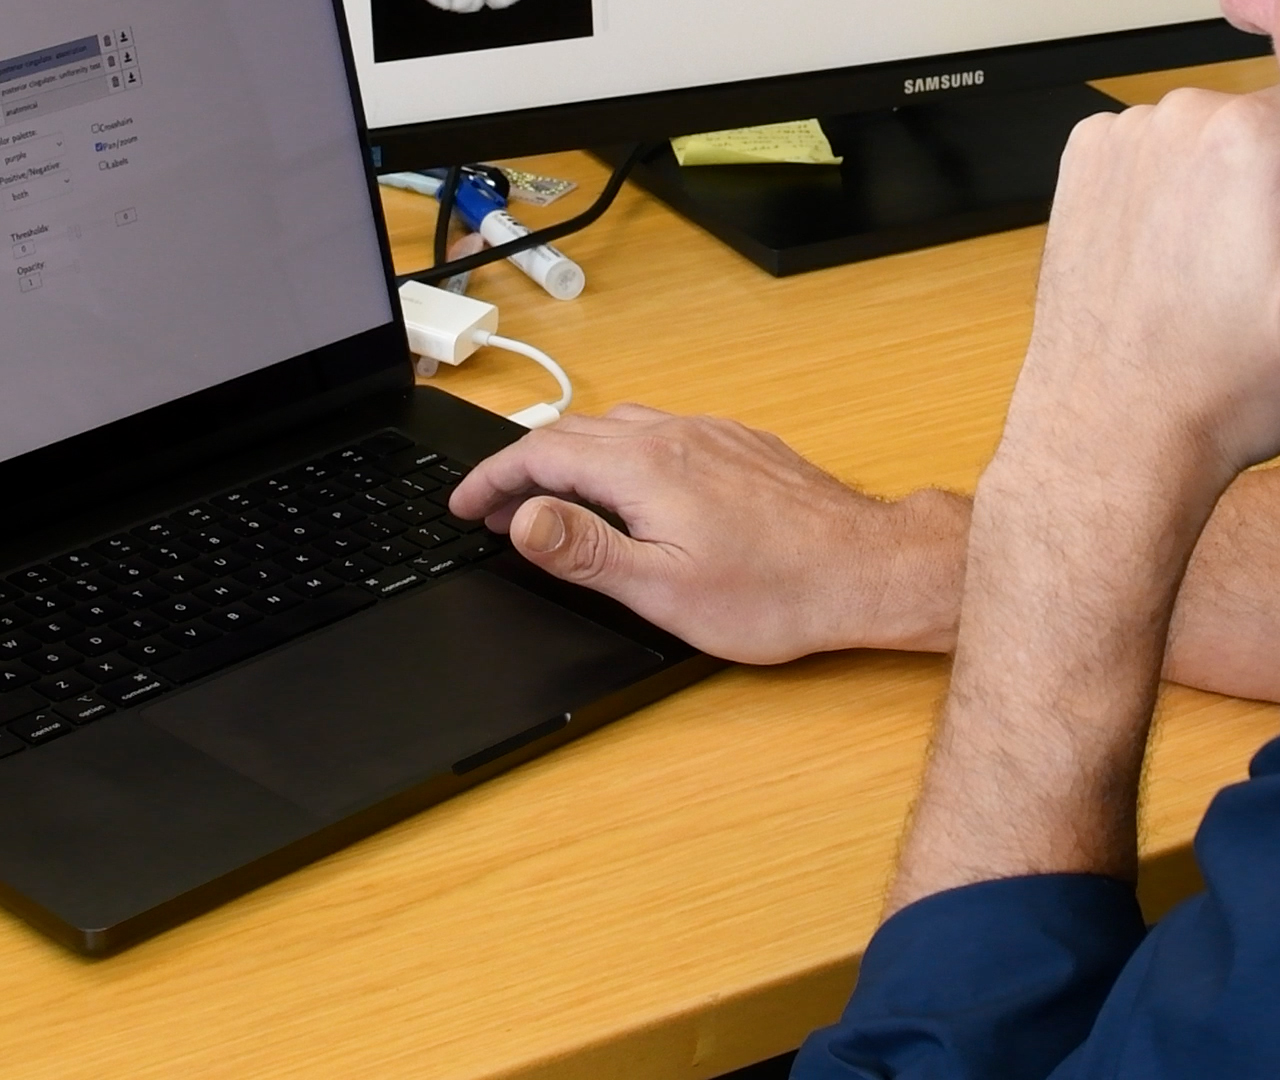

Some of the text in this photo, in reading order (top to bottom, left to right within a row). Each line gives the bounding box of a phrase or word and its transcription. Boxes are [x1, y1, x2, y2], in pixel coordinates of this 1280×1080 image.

[904, 69, 984, 95] SAMSUNG
[5, 101, 38, 116] anatomical
[99, 116, 134, 133] Crosshairs
[103, 134, 138, 151] Pan/zoom
[4, 151, 27, 166] purple
[106, 157, 129, 170] Labels
[12, 190, 29, 201] both
[215, 587, 228, 595] H
[100, 663, 112, 671] X
[307, 579, 321, 587] M
[2, 640, 17, 648] W
[31, 723, 60, 737] control
[79, 705, 105, 717] option
[122, 682, 160, 700] command
[382, 575, 417, 592] command
[430, 560, 453, 572] option
